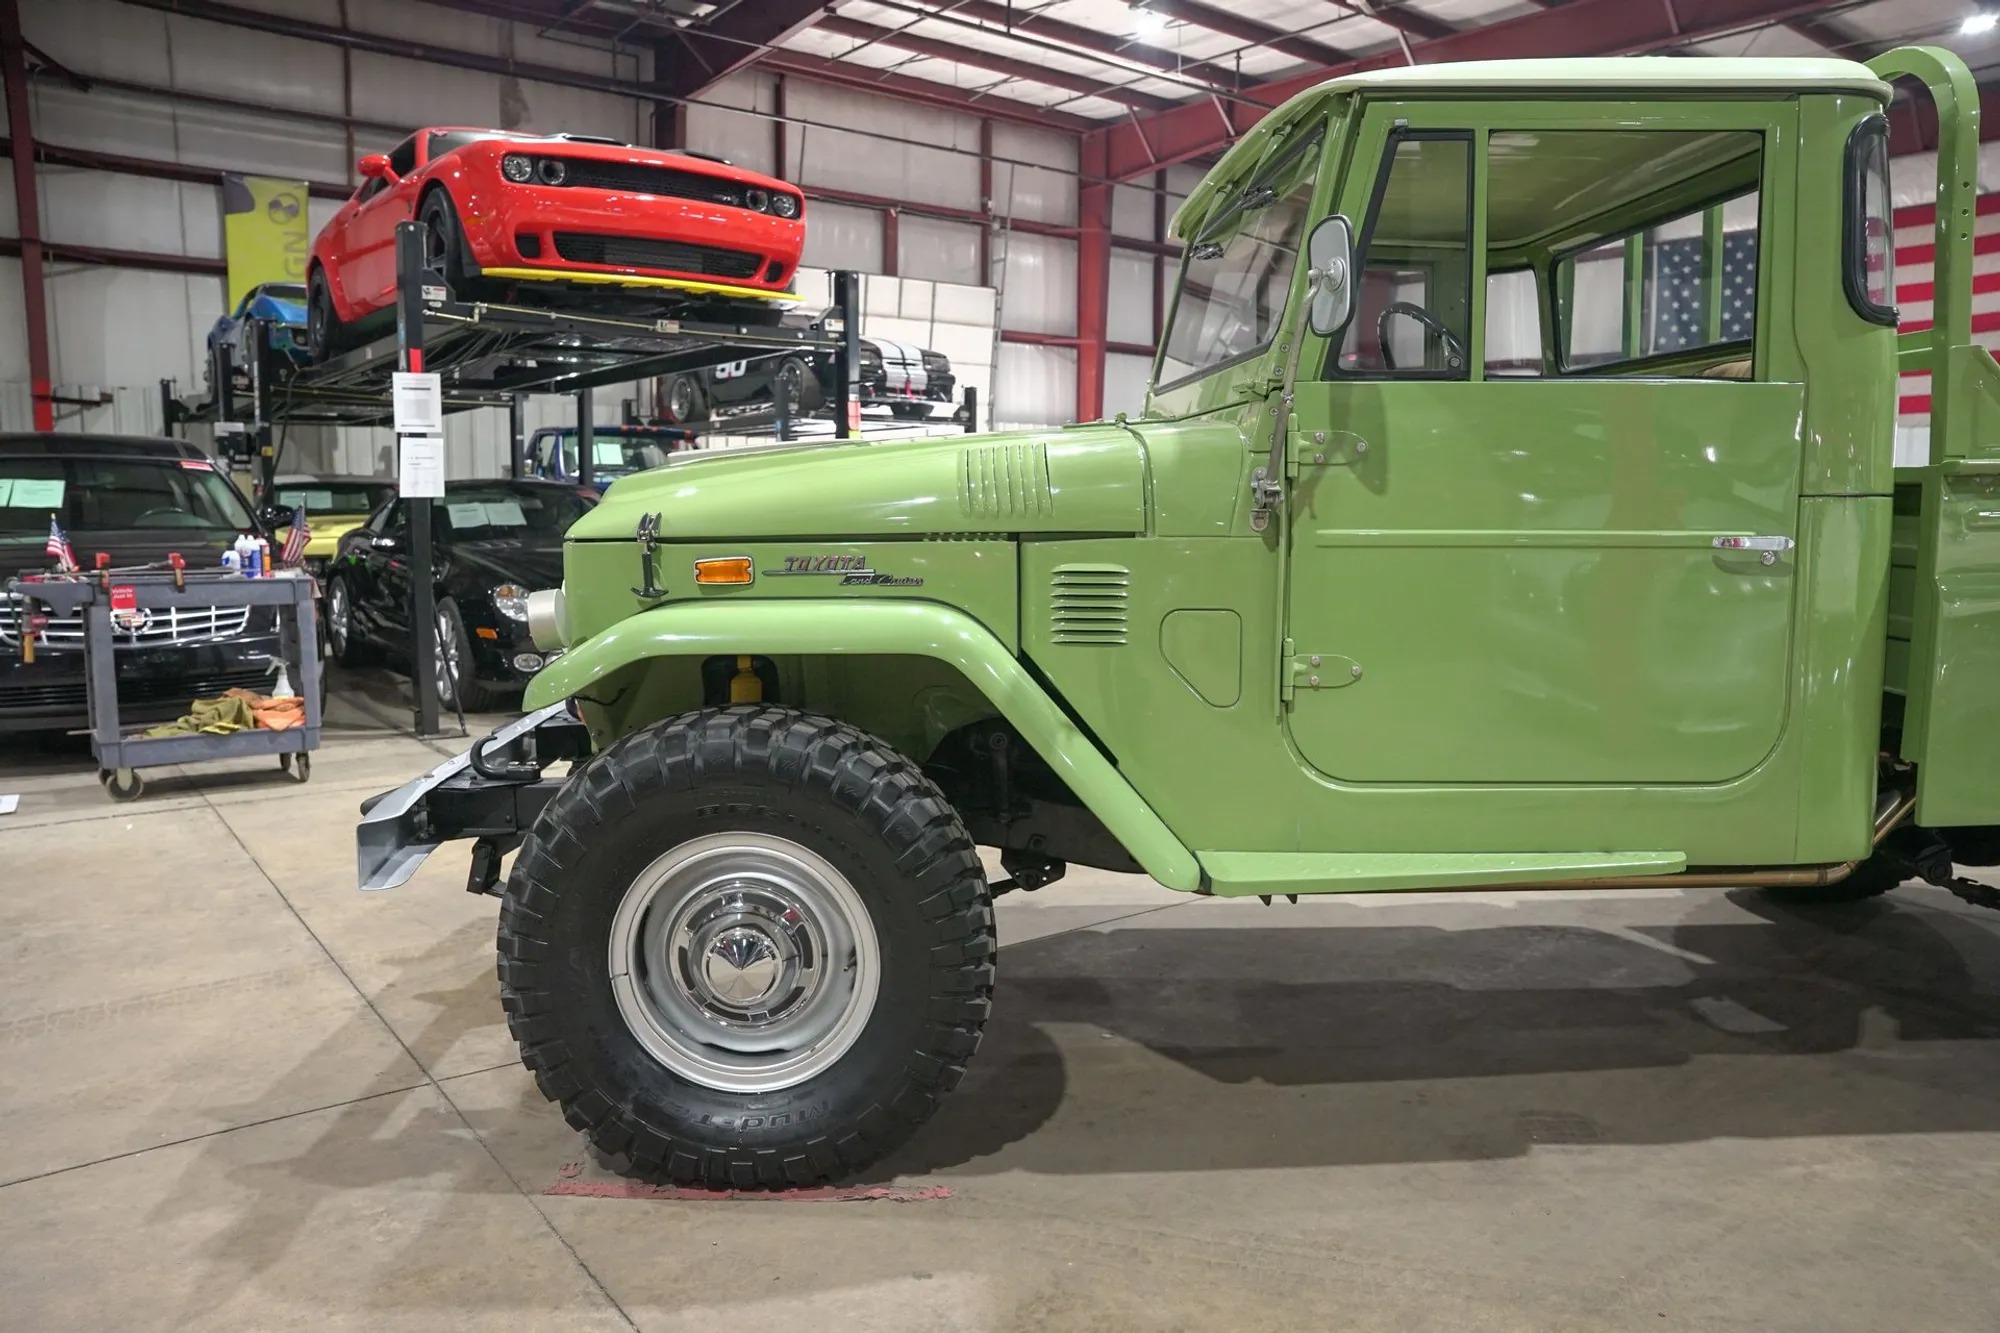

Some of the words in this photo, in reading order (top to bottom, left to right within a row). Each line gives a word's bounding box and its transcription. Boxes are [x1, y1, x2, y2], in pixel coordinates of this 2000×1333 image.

[784, 555, 867, 572] TOYOTA
[839, 573, 873, 586] Land
[876, 573, 925, 587] Cruiser
